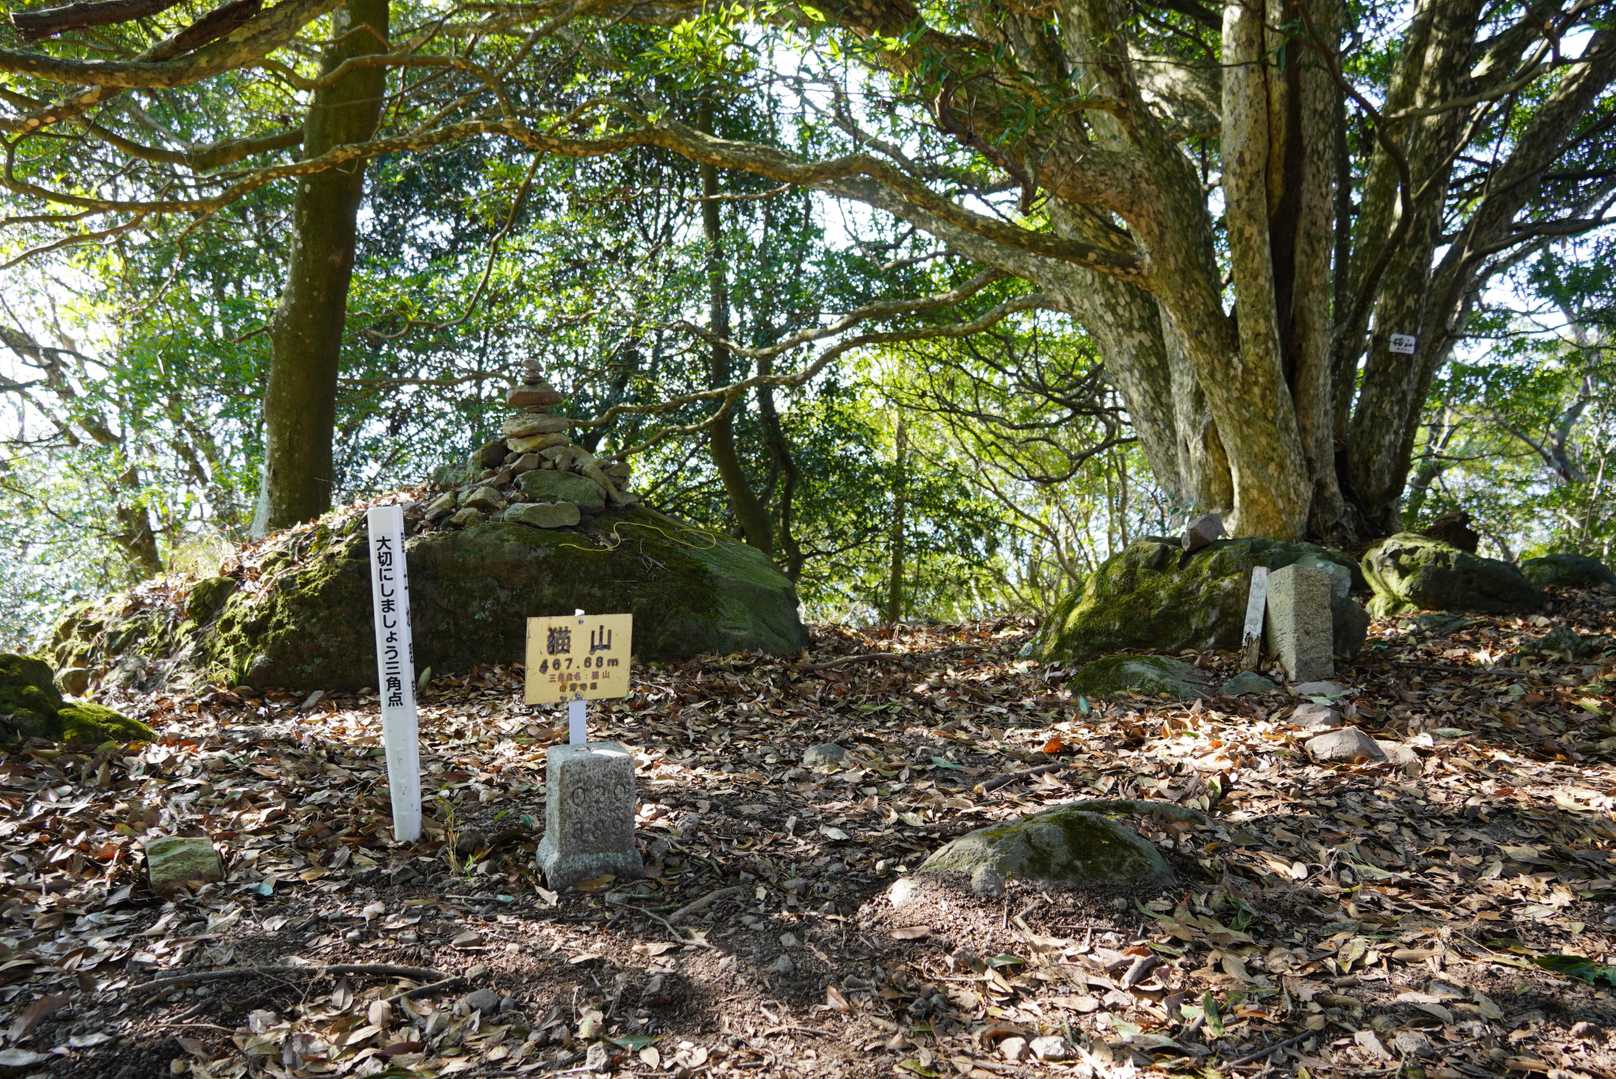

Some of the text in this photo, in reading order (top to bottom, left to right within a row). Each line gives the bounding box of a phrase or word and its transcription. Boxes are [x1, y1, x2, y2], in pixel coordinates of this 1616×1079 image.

[375, 535, 404, 708] 大切にしましょう三角点
